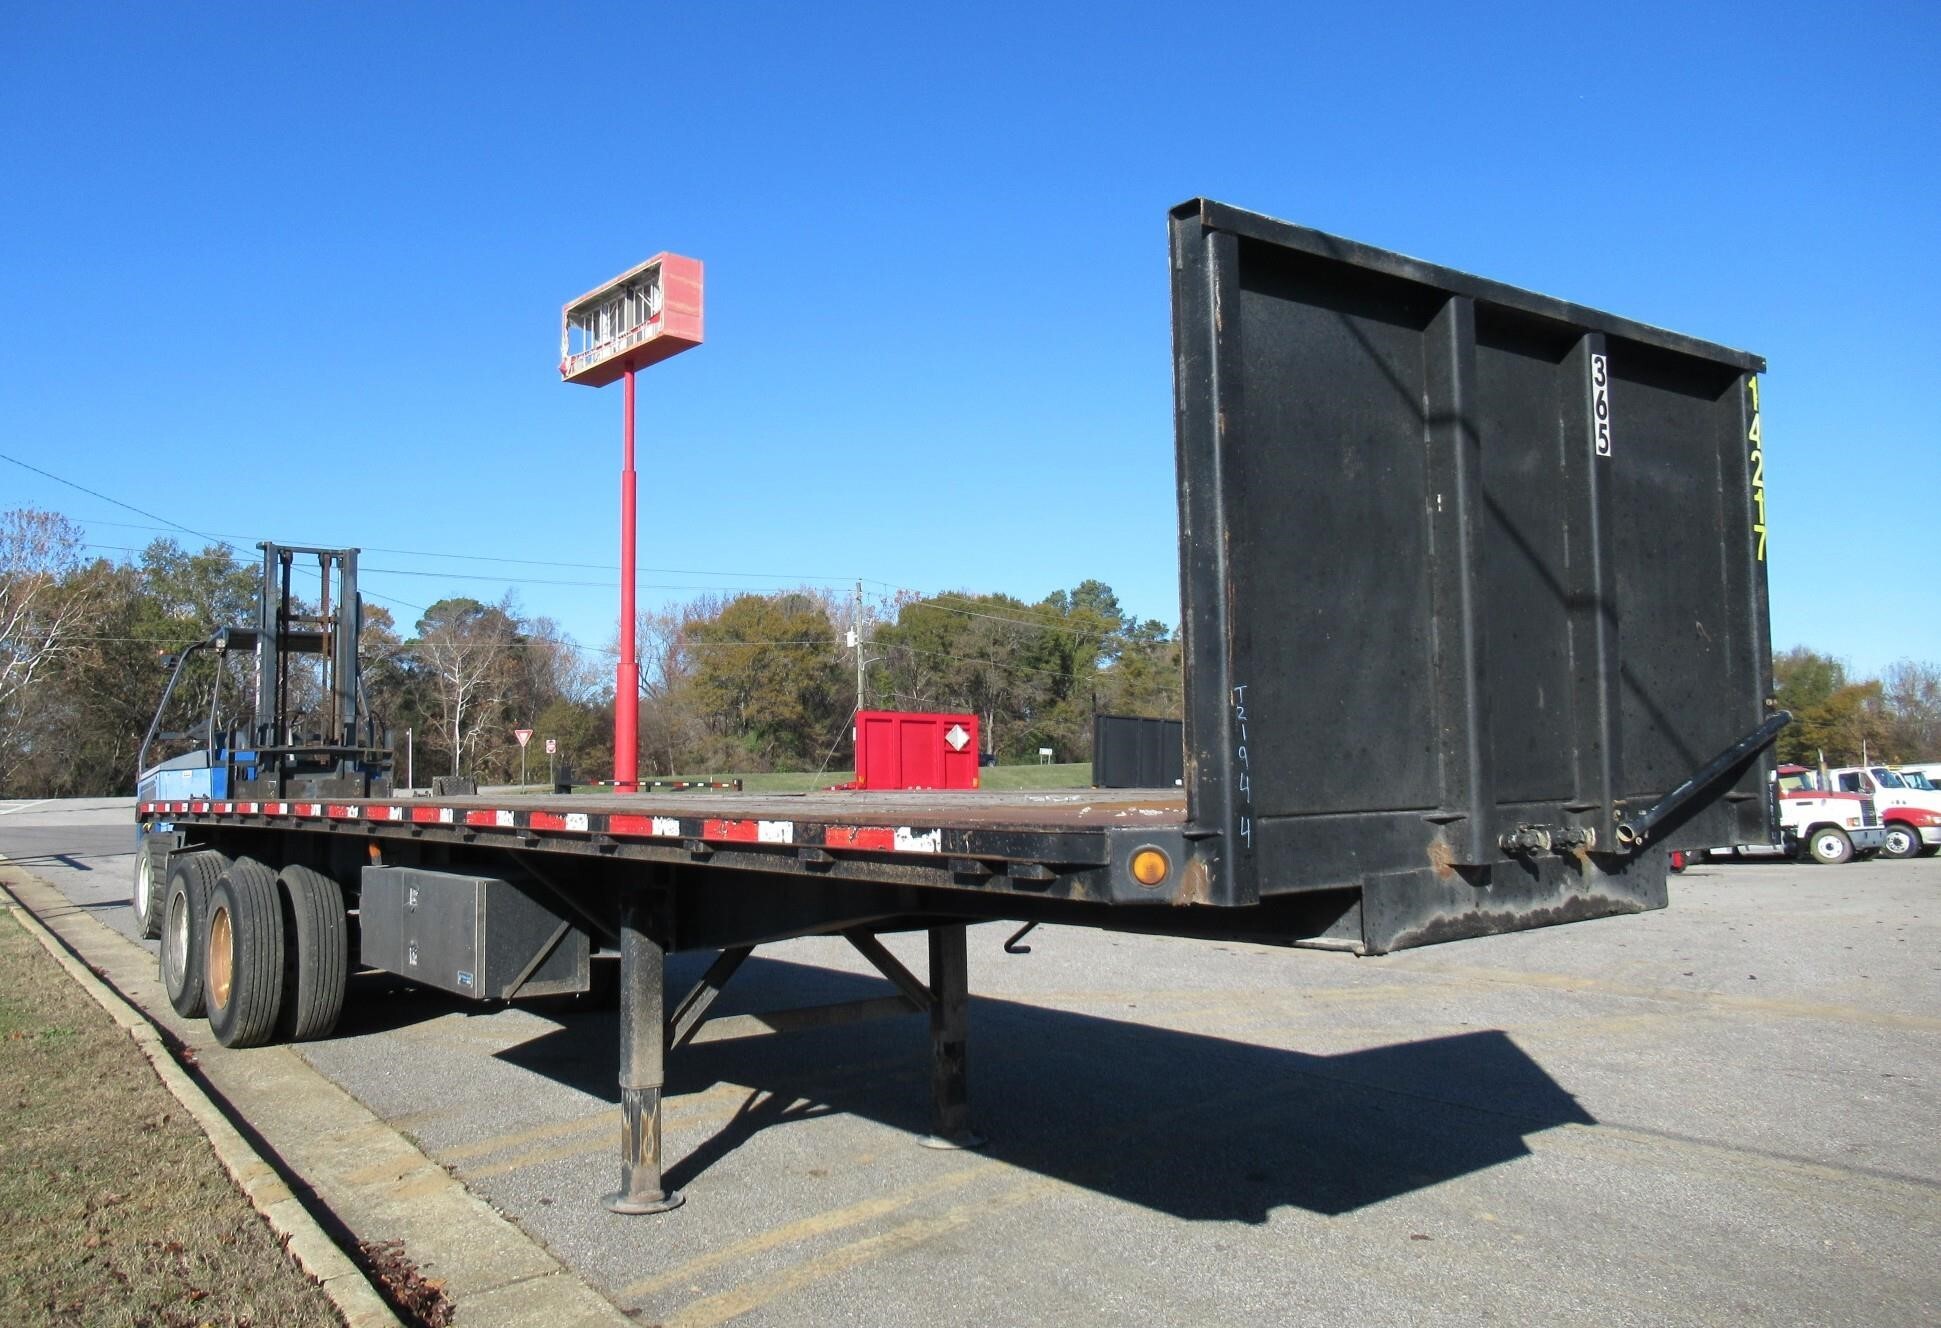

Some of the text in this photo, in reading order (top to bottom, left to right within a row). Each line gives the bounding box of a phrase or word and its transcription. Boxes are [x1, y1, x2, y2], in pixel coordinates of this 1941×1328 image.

[1593, 356, 1610, 454] 365
[1748, 375, 1767, 561] 14217
[1233, 684, 1251, 849] T21944
